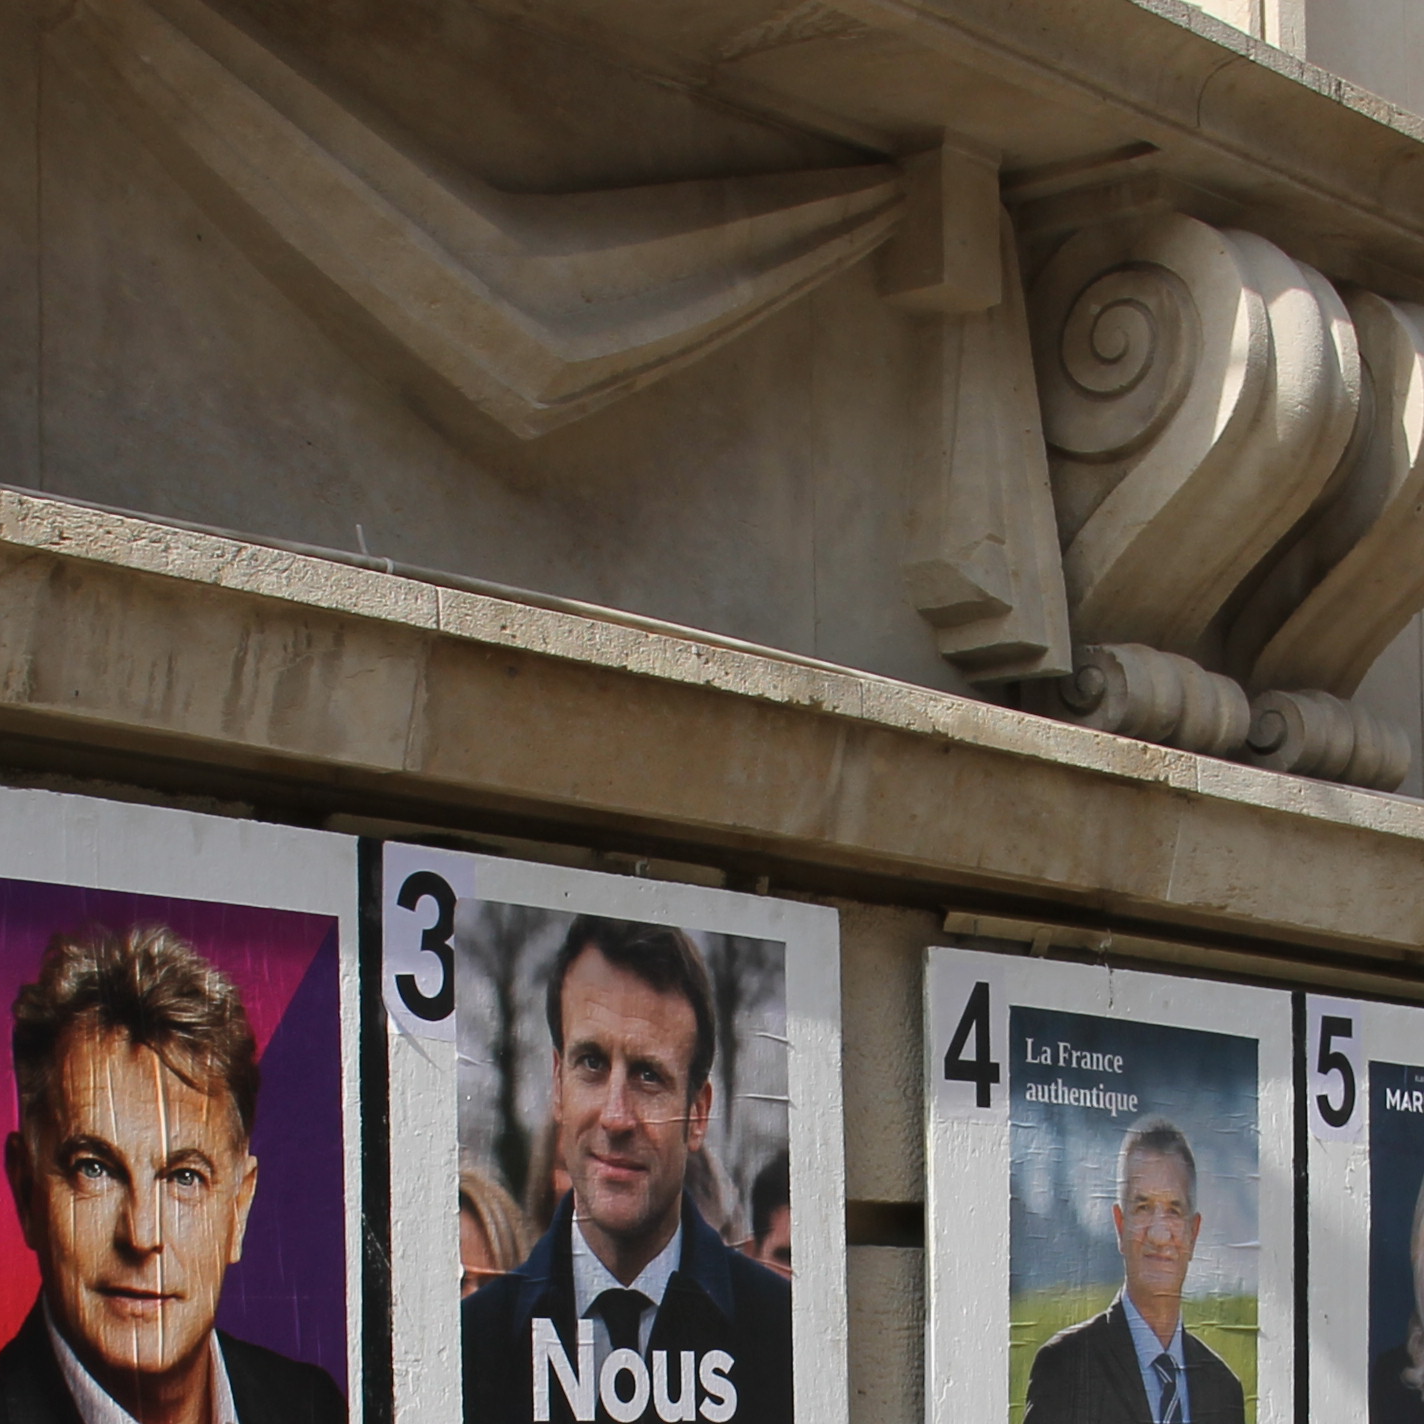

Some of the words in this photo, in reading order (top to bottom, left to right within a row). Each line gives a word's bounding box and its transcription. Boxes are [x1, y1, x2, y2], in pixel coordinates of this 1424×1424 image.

[395, 871, 456, 1021] 3
[944, 981, 1001, 1109] 4
[1025, 1037, 1052, 1065] La
[1057, 1041, 1124, 1074] France
[1026, 1079, 1138, 1118] authentique
[1315, 1015, 1355, 1128] 5
[532, 1317, 738, 1424] Nous
